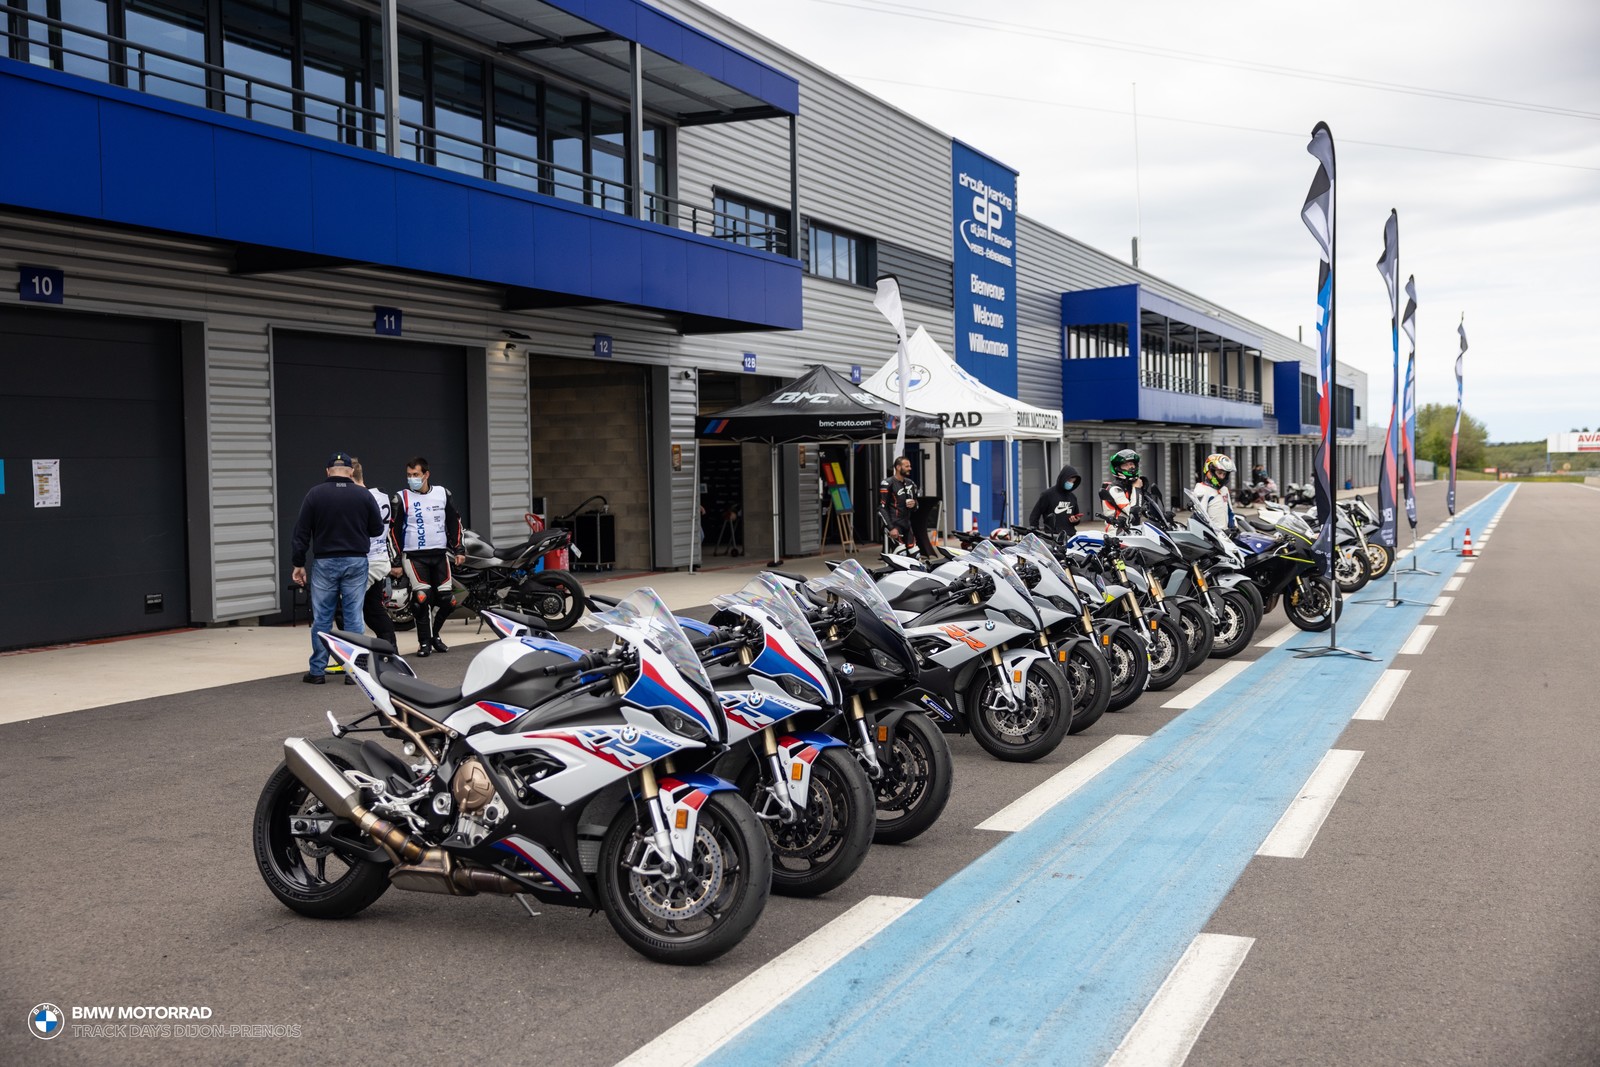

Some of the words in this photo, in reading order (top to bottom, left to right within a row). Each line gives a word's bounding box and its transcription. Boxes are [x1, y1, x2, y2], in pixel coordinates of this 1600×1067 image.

[32, 275, 53, 296] 10
[971, 273, 1005, 301] Bienvenue
[384, 314, 395, 330] 11
[973, 304, 1004, 329] Welcome
[599, 340, 609, 353] 12
[968, 332, 1009, 358] Willkommen
[744, 357, 756, 368] 12B
[772, 391, 839, 404] BMC
[819, 420, 872, 428] bmc-moto.com
[1016, 410, 1031, 427] BMW
[1030, 412, 1058, 430] MOTORRAD
[381, 503, 391, 525] 2
[765, 694, 801, 711] S1000
[643, 729, 682, 748] S1000
